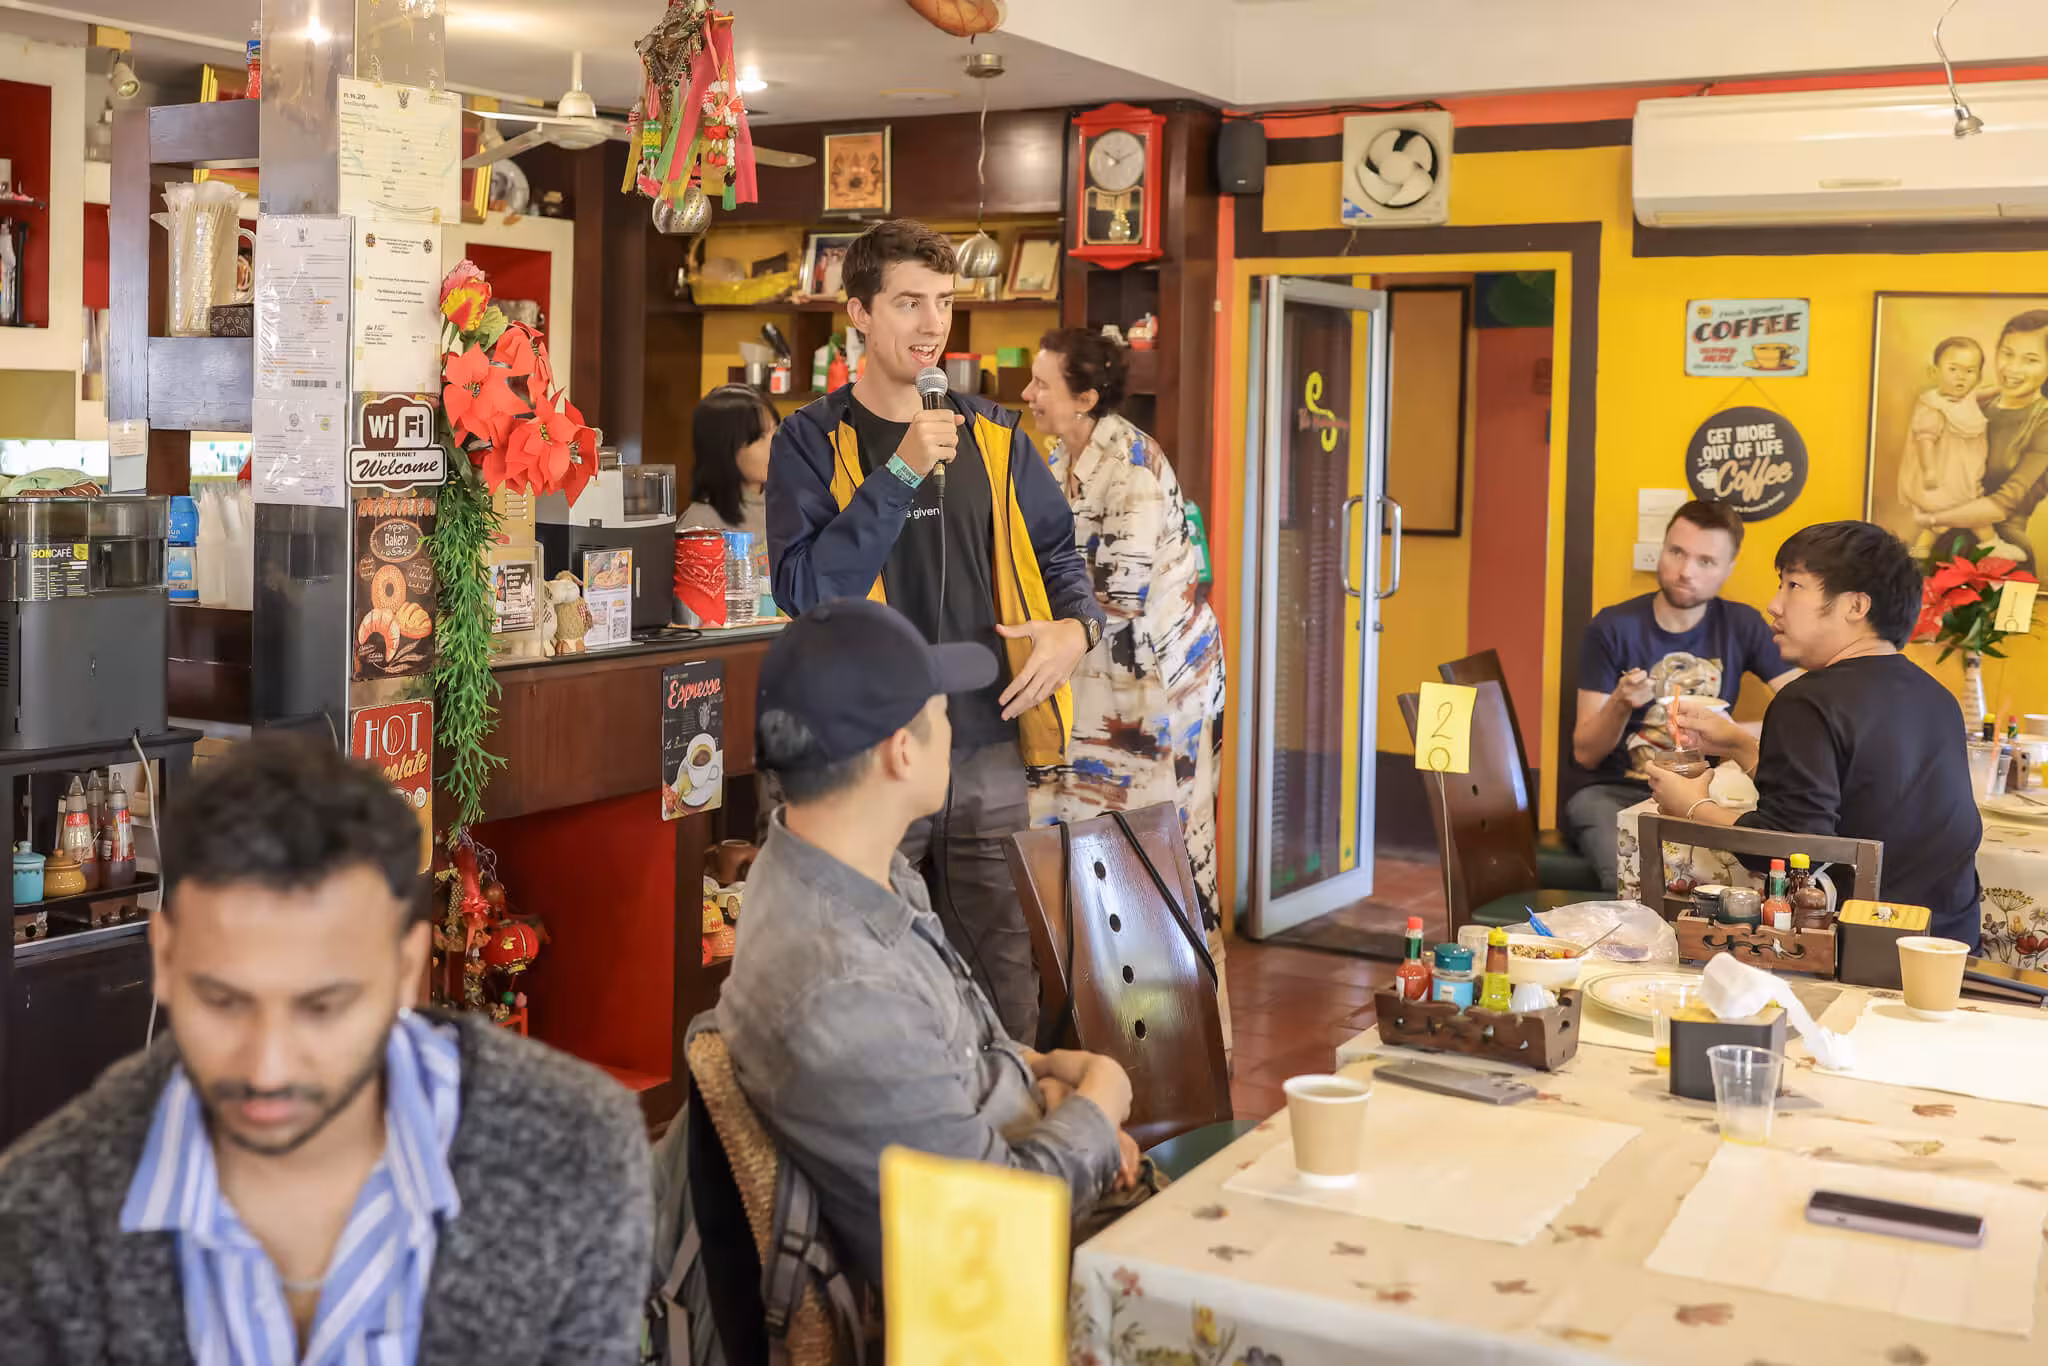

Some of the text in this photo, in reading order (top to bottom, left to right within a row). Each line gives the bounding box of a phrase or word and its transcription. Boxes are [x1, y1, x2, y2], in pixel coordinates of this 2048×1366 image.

[1693, 312, 1802, 344] COFFEE
[1707, 423, 1776, 445] GET MORE
[1702, 439, 1784, 460] OUT OF LIFE
[356, 459, 439, 479] Welcome
[1714, 456, 1793, 502] Coffee
[913, 507, 940, 519] given
[385, 532, 409, 547] Bakery
[32, 547, 72, 558] BONCAFÉ
[668, 678, 720, 709] Espresso
[1431, 701, 1453, 739] 2
[365, 712, 422, 760] HOT
